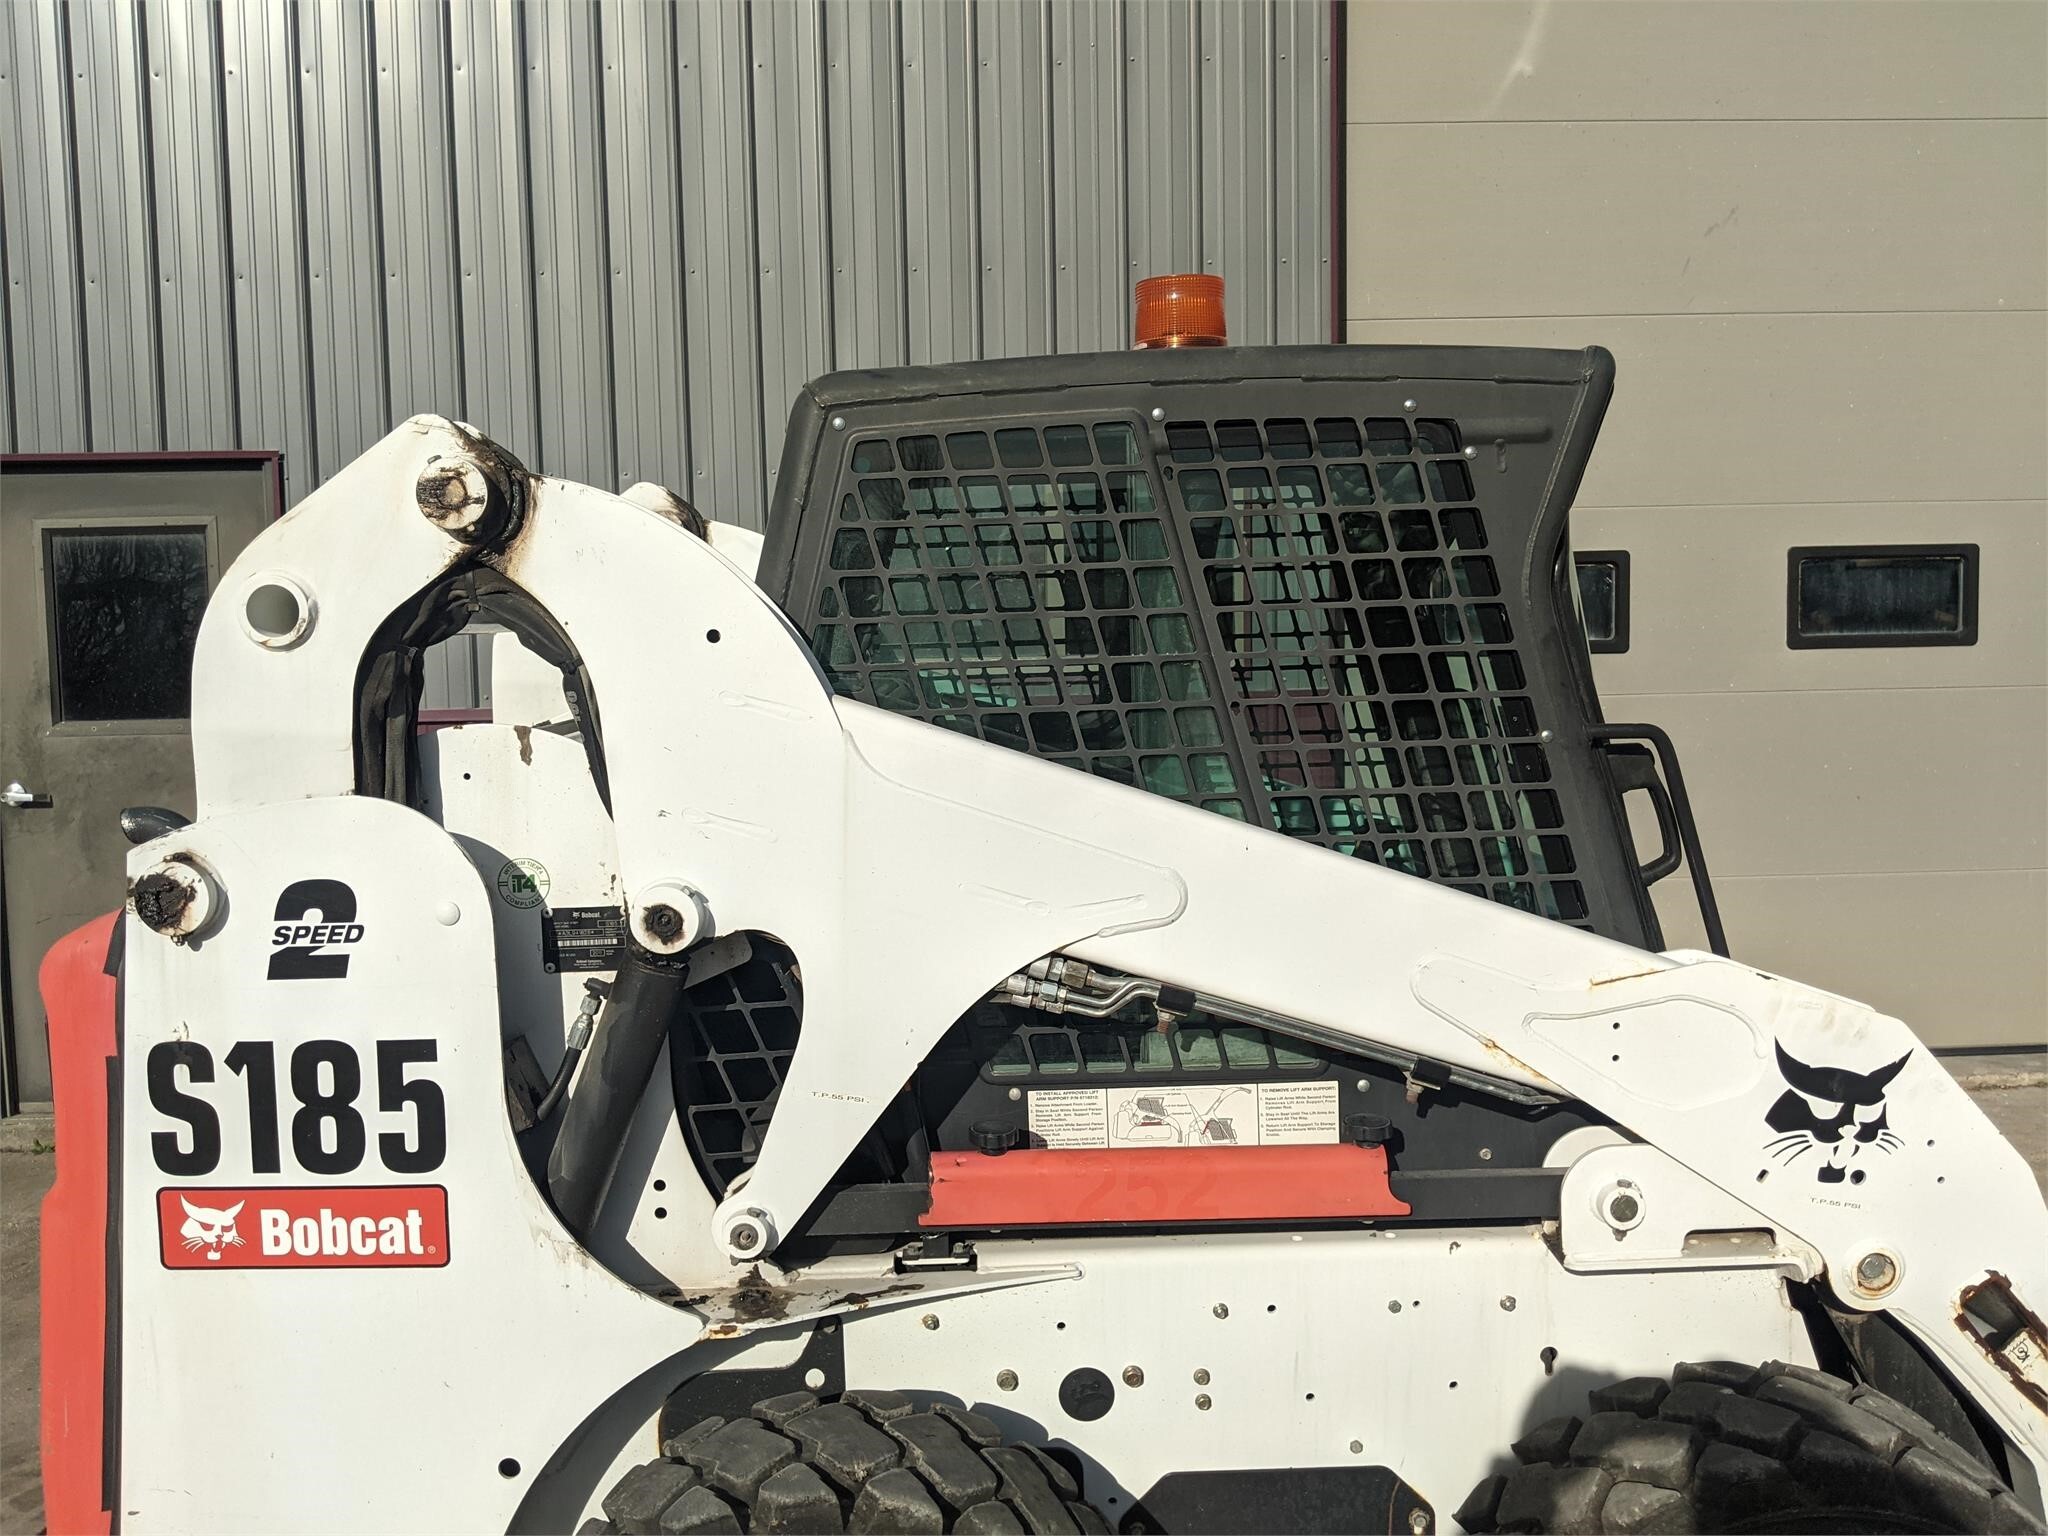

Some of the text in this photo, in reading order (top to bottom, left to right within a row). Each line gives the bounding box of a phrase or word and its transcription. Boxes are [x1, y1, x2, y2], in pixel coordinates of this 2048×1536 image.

[506, 894, 543, 906] COMPLIANT
[267, 879, 357, 980] 2
[272, 924, 364, 946] SPEED
[147, 1038, 446, 1176] S185
[260, 1208, 424, 1256] Bobcat
